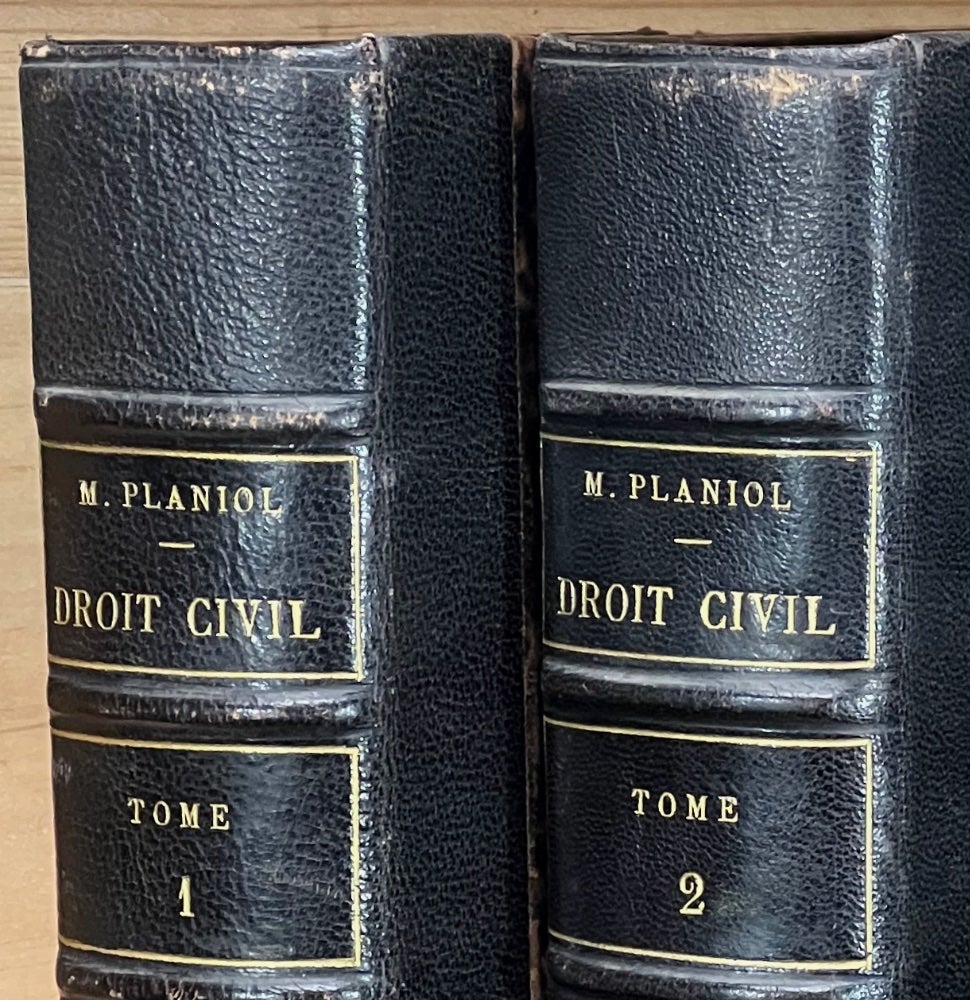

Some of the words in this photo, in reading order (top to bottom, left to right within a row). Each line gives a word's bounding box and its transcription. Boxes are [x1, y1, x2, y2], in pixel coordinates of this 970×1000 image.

[78, 479, 109, 507] M.
[121, 481, 284, 517] PLANIOL
[583, 470, 616, 499] M.
[628, 473, 792, 510] PLANIOL
[53, 586, 161, 634] DROIT
[186, 597, 321, 640] CIVIL
[557, 576, 674, 626] DROIT
[699, 590, 836, 636] CIVIL
[127, 797, 231, 831] TOME
[631, 787, 739, 824] TOME
[178, 875, 195, 918] 1
[678, 871, 706, 916] 2
